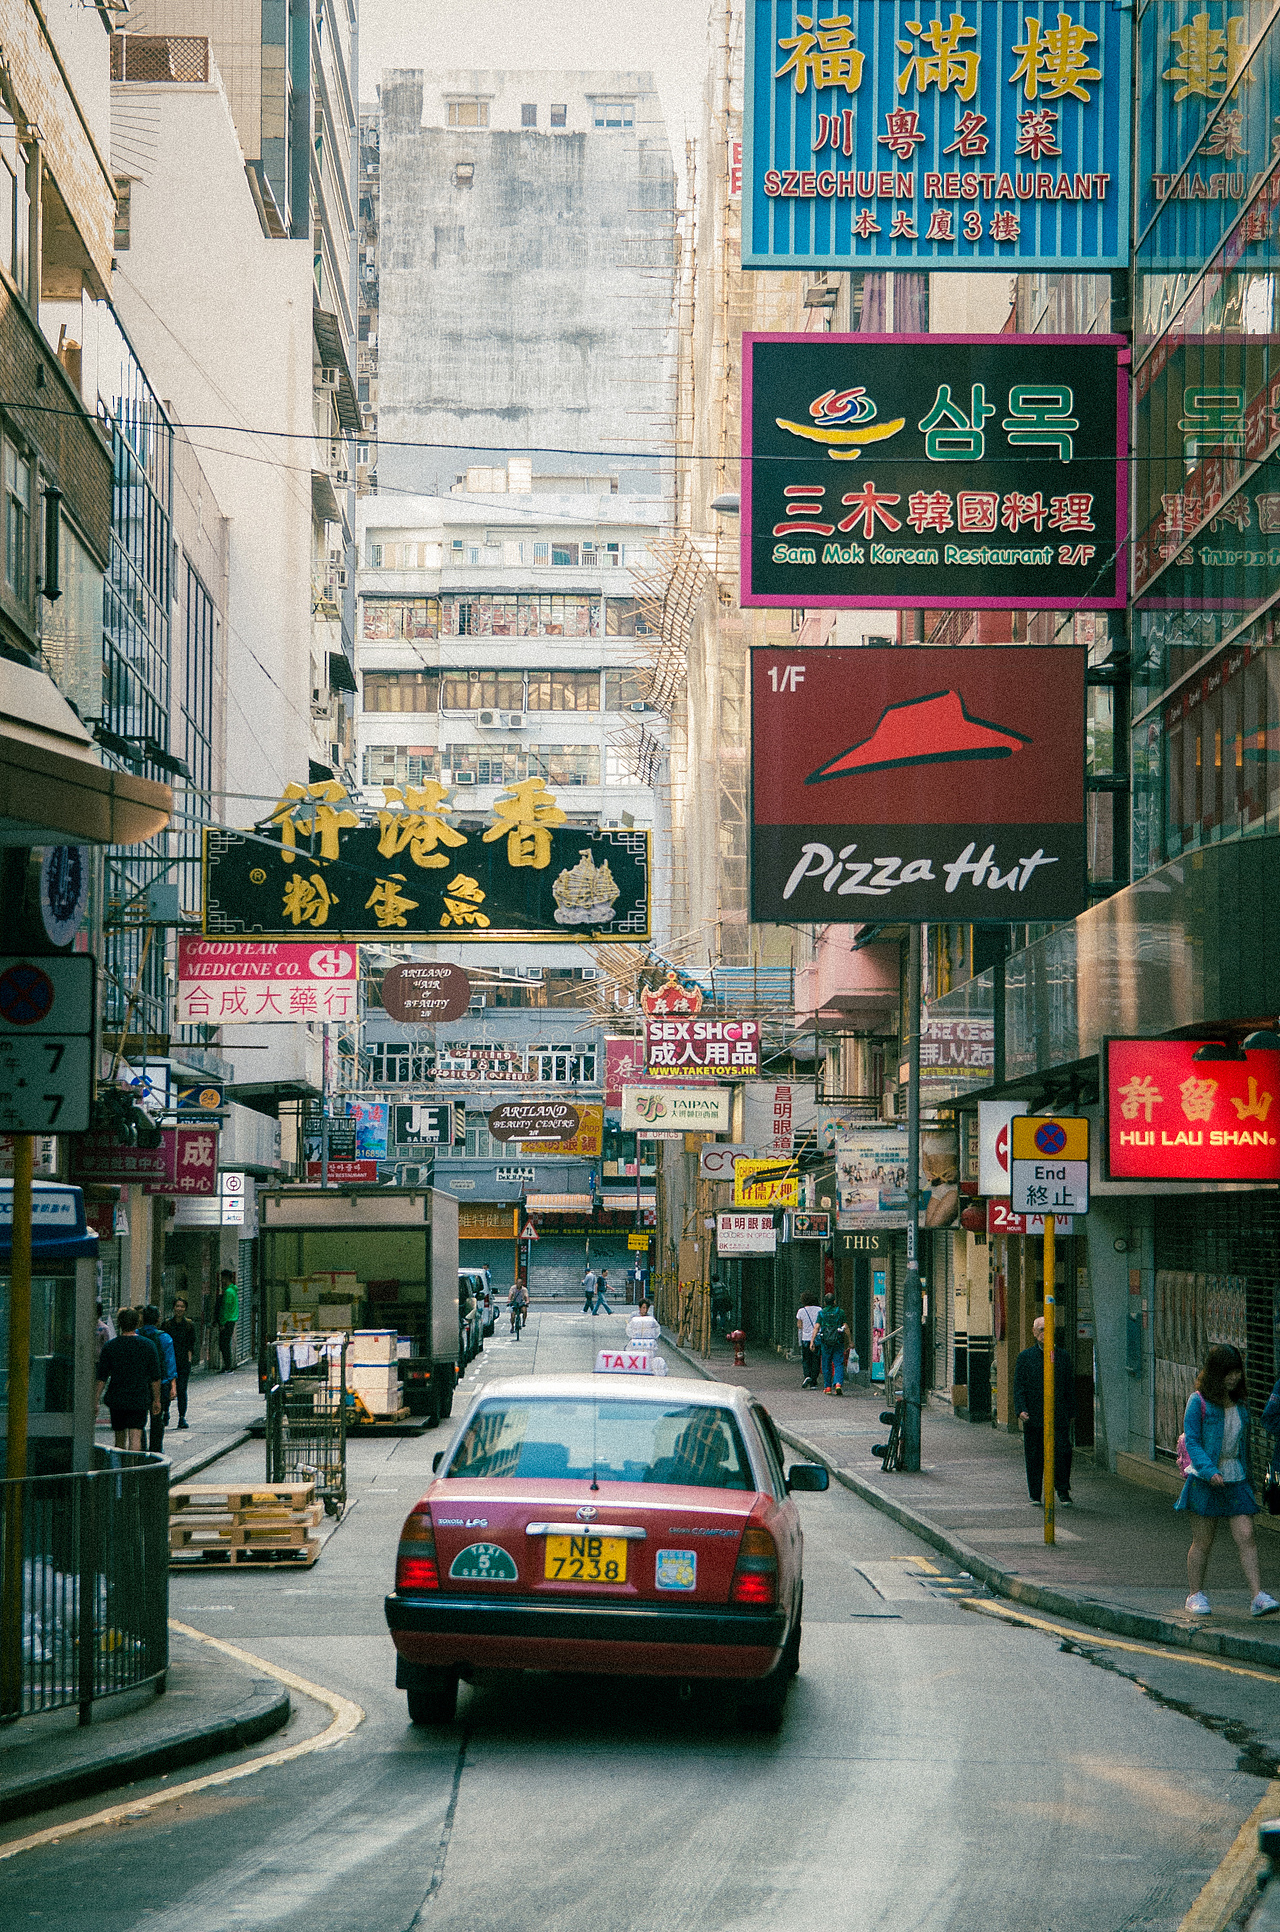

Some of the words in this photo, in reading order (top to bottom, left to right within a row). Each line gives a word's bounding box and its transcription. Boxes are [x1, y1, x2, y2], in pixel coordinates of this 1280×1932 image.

[775, 14, 1101, 102] 福滿樓
[764, 170, 914, 198] SZECHUEN
[924, 172, 1110, 200] RESTAURANT
[918, 383, 1080, 463] 삼목
[772, 481, 1096, 539] 三木韓國料理
[772, 545, 817, 565] Sam
[822, 545, 863, 565] Mok
[870, 545, 938, 565] Korean
[945, 545, 1053, 565] Restaurant
[1058, 545, 1096, 566] 2/F
[767, 665, 806, 692] 1/F
[783, 842, 936, 900] Pizza
[942, 842, 1060, 893] Hut
[186, 943, 278, 957] GOODYEAR
[185, 962, 271, 977] MEDICINE
[276, 962, 302, 977] CO.
[400, 968, 452, 978] ARTLAND
[413, 980, 441, 990] HAIR
[184, 986, 353, 1017] 合成大藥行
[404, 999, 450, 1010] BEAUTY
[650, 1023, 690, 1041] SEX
[44, 1044, 65, 1073] 7
[650, 1042, 757, 1066] 成人用品
[649, 1066, 757, 1076] WWW.TAKETOYS.HK
[671, 1100, 719, 1109] TAIPAN
[1117, 1075, 1273, 1122] 許留山
[43, 1094, 64, 1124] 7
[501, 1105, 567, 1118] ARTLAND
[493, 1120, 532, 1129] BEAUTY
[536, 1119, 575, 1128] CENTRE
[773, 1086, 792, 1152] 昌明眼鏡
[1120, 1131, 1155, 1146] HUI
[1161, 1131, 1202, 1146] LAU
[1035, 1166, 1066, 1180] End
[1026, 1185, 1075, 1207] 終止
[722, 1217, 773, 1229] 昌明眼鏡
[994, 1206, 1021, 1225] 24
[843, 1236, 879, 1249] THIS
[602, 1355, 647, 1370] TAXI
[465, 1519, 489, 1528] LPG
[471, 1547, 500, 1557] TAXI
[570, 1537, 603, 1558] NB
[479, 1555, 490, 1568] 5
[552, 1558, 620, 1580] 7238
[462, 1568, 506, 1578] SEATS
